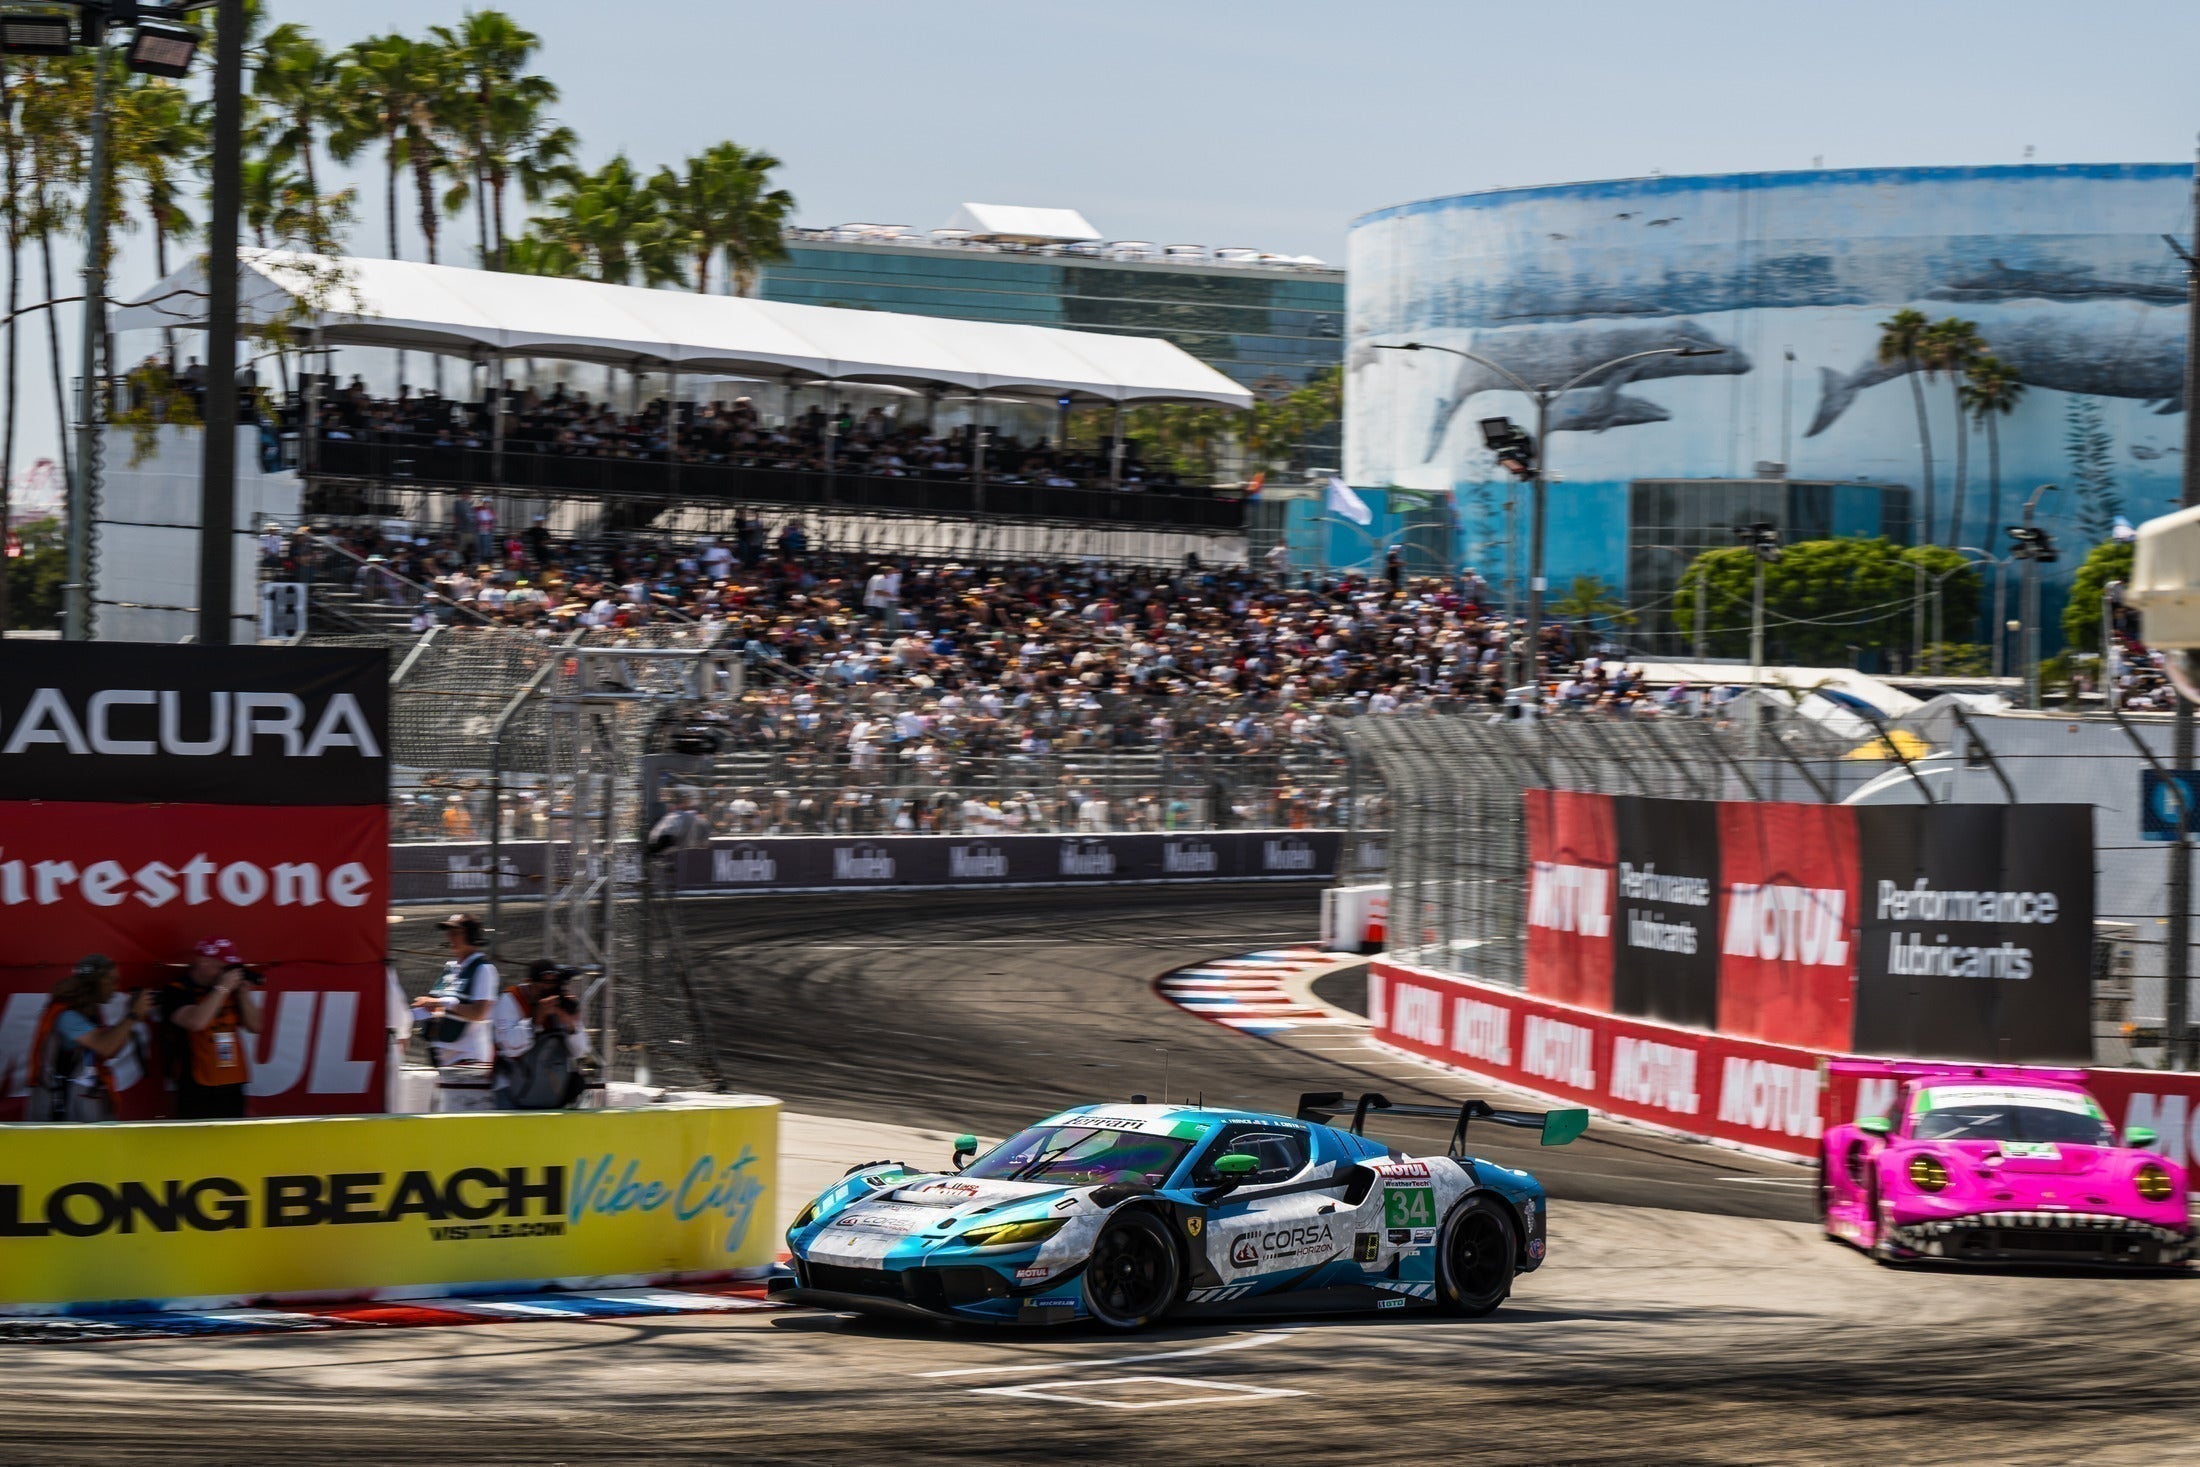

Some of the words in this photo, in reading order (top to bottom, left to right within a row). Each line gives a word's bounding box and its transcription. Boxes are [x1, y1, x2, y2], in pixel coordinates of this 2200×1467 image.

[2, 688, 383, 758] ACURA
[1722, 882, 1849, 966] MOTUL
[1877, 877, 2060, 925] Performance
[1888, 931, 2034, 980] lubricants
[1717, 1056, 1824, 1139] MOTUL
[1378, 1162, 1428, 1177] MOTUL
[0, 1176, 250, 1238] LONG
[264, 1165, 568, 1229] BEACH
[566, 1153, 672, 1226] Vibe
[674, 1145, 766, 1253] City
[1392, 1190, 1430, 1226] 34
[1263, 1224, 1333, 1251] CORSA
[1297, 1243, 1333, 1257] HORIZON
[1016, 1269, 1047, 1278] MOTUL
